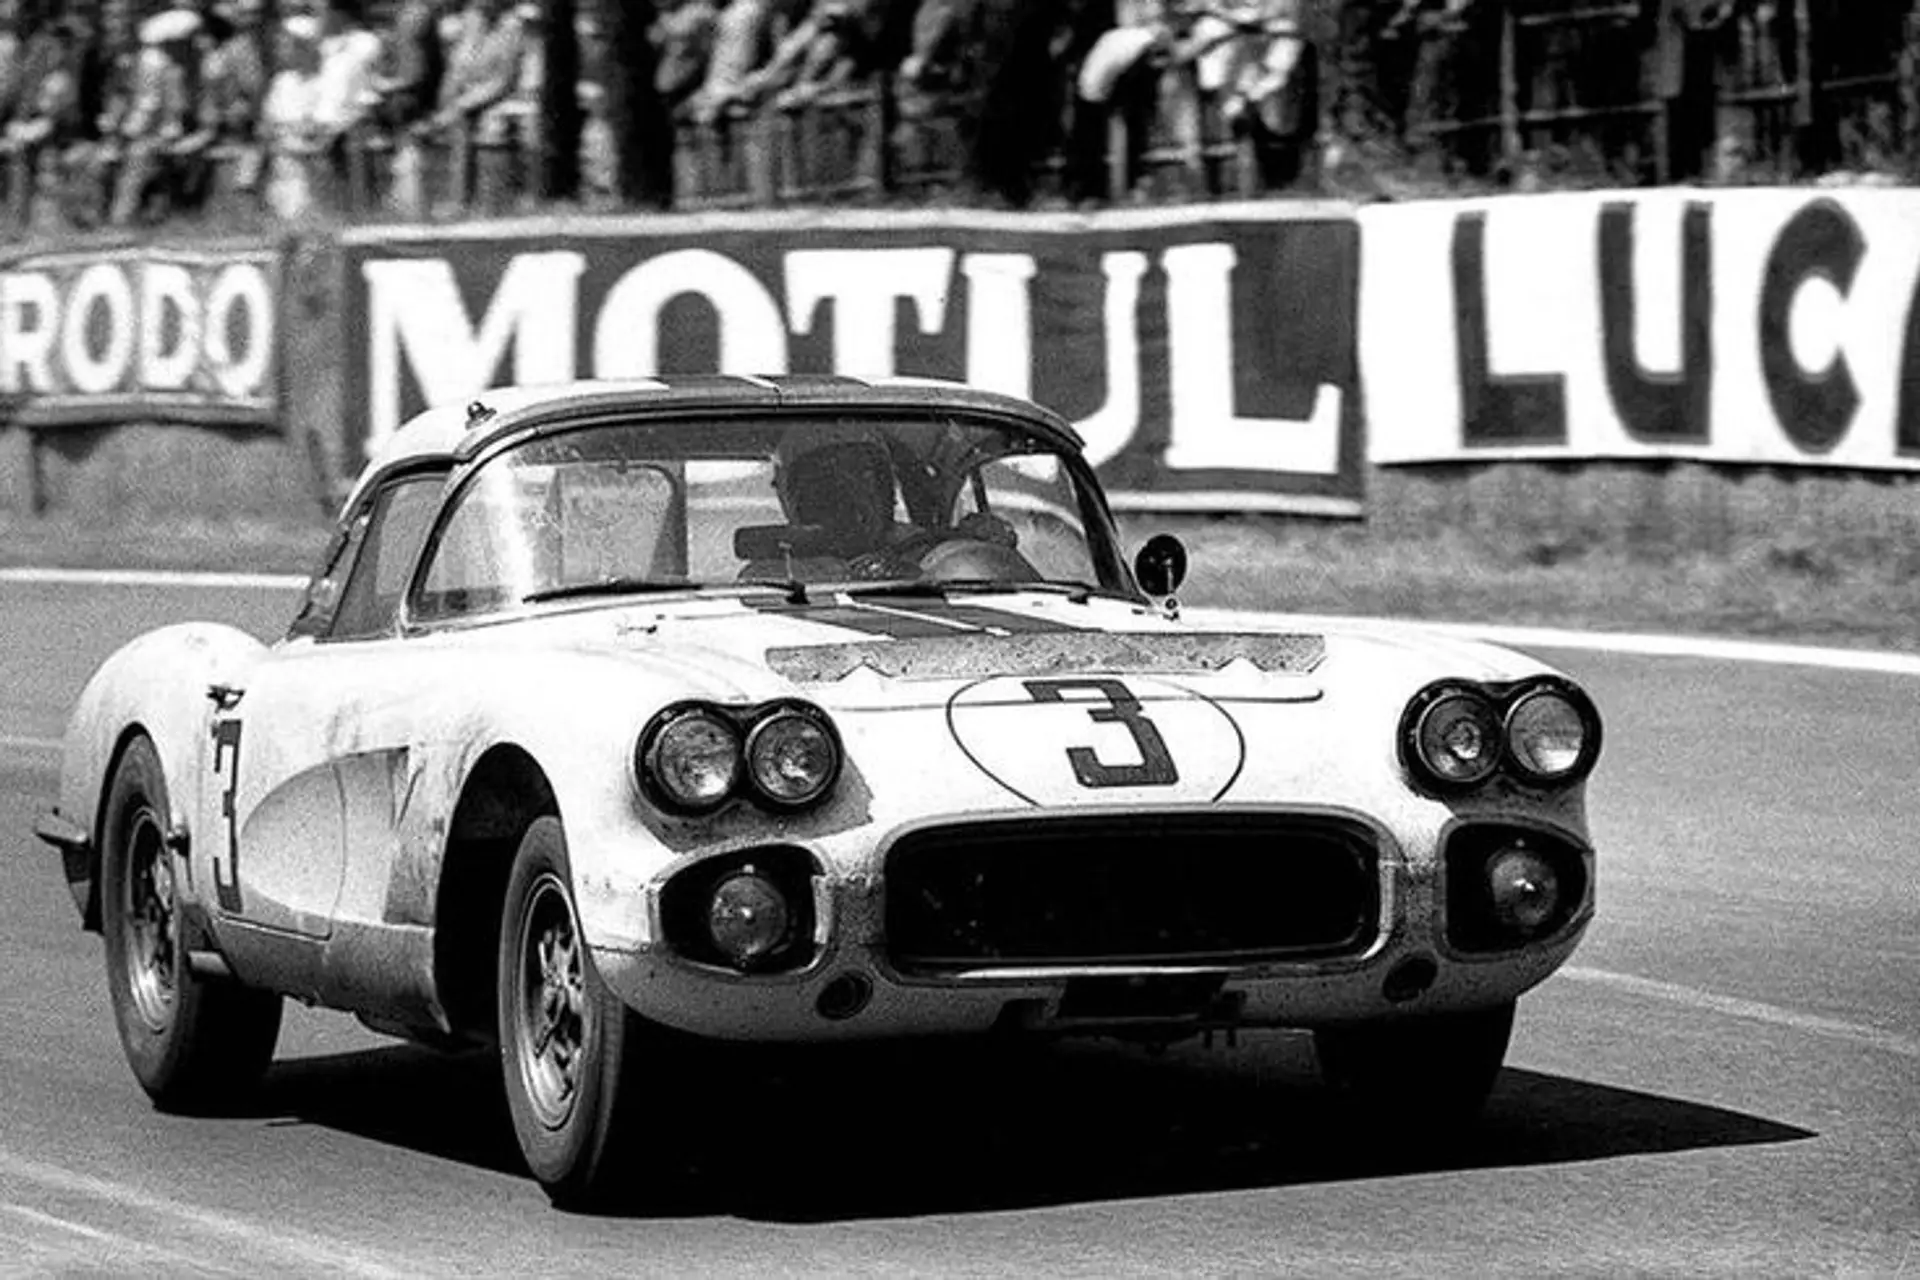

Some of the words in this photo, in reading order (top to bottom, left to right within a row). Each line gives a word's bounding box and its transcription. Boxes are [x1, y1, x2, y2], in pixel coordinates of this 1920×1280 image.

[362, 242, 1342, 474] MOTUL
[1450, 197, 1920, 456] LUC
[211, 719, 244, 915] 3
[1022, 679, 1180, 788] 3
